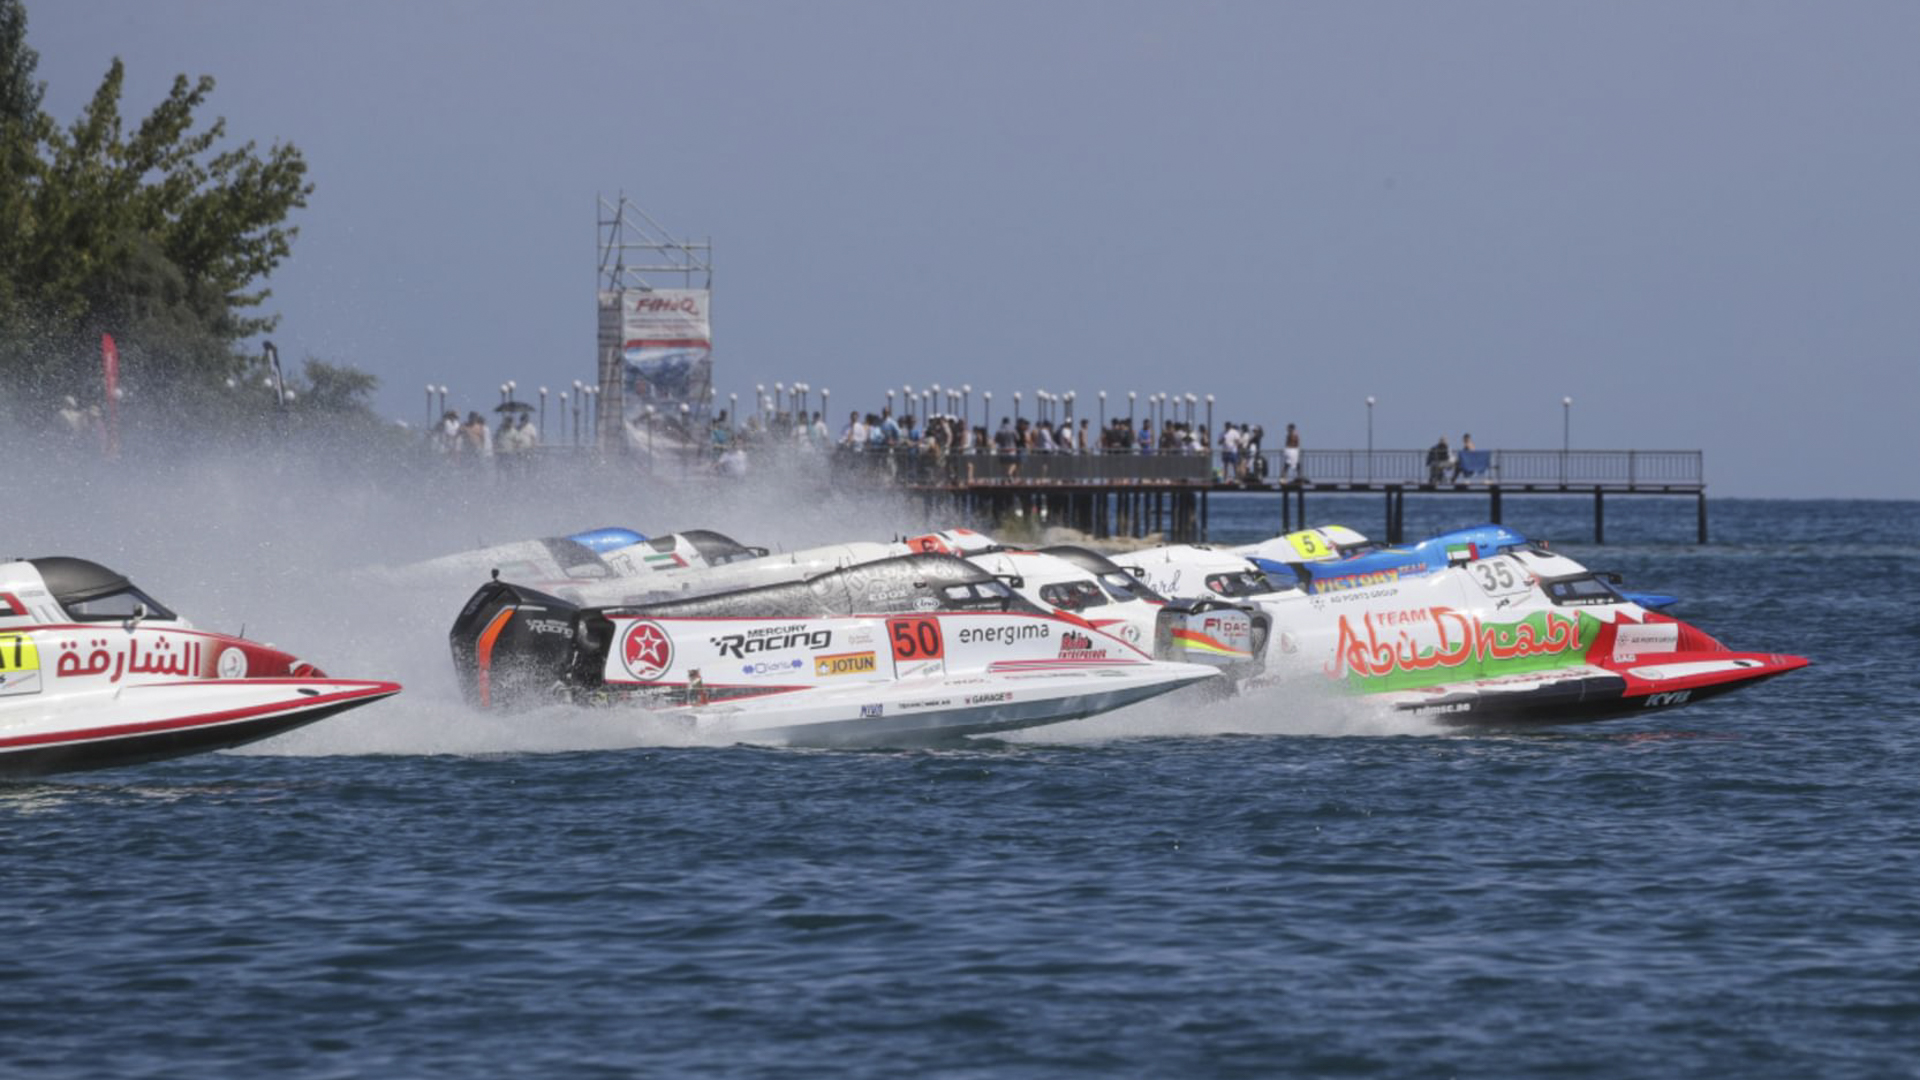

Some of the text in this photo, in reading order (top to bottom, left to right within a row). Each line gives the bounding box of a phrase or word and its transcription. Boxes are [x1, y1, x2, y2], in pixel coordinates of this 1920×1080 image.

[1302, 534, 1316, 553] 5
[1313, 569, 1398, 594] VICTORY
[1476, 562, 1514, 591] 35
[1378, 608, 1427, 627] TEAM
[748, 624, 807, 638] MERCURY
[893, 621, 939, 657] 50
[718, 630, 832, 659] Racing
[57, 635, 200, 683] الشارقة
[831, 657, 874, 673] JOTUN
